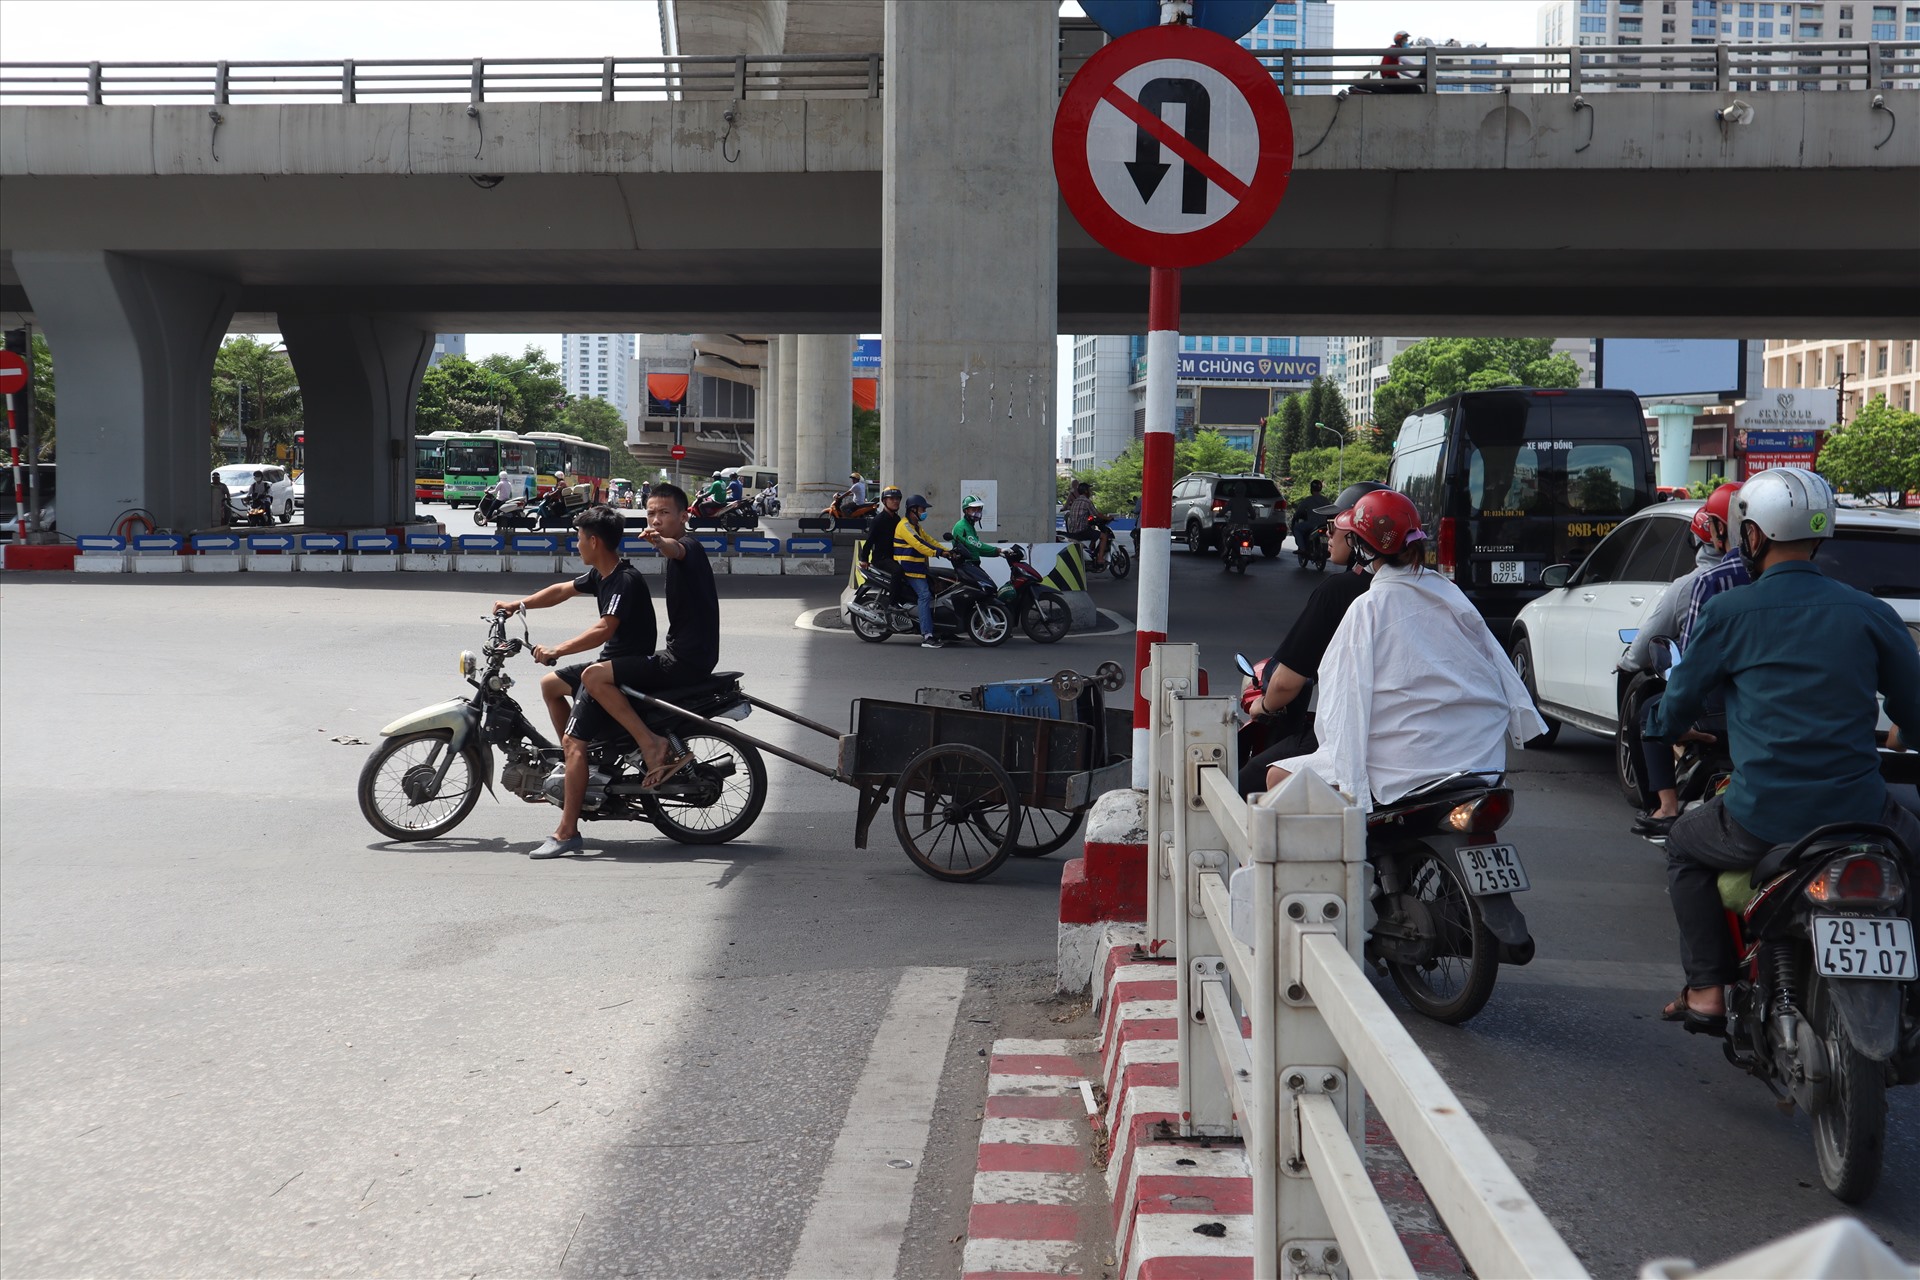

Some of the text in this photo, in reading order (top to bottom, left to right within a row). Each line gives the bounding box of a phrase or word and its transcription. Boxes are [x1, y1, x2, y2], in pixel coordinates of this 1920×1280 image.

[1198, 357, 1255, 374] CHỦNG
[1273, 361, 1317, 375] VNVC
[1526, 440, 1574, 452] XE HỢP ĐỒNG
[1748, 459, 1812, 470] THÁI BẢO MOTOR
[967, 535, 982, 548] Grab
[1475, 545, 1514, 553] HYUNDAI
[1499, 562, 1517, 572] 98B
[1492, 572, 1523, 583] 027.54
[1467, 847, 1514, 870] 30-M2
[1474, 868, 1520, 891] 2559
[1828, 920, 1896, 947] 29-T1
[1824, 948, 1907, 976] 457.07
